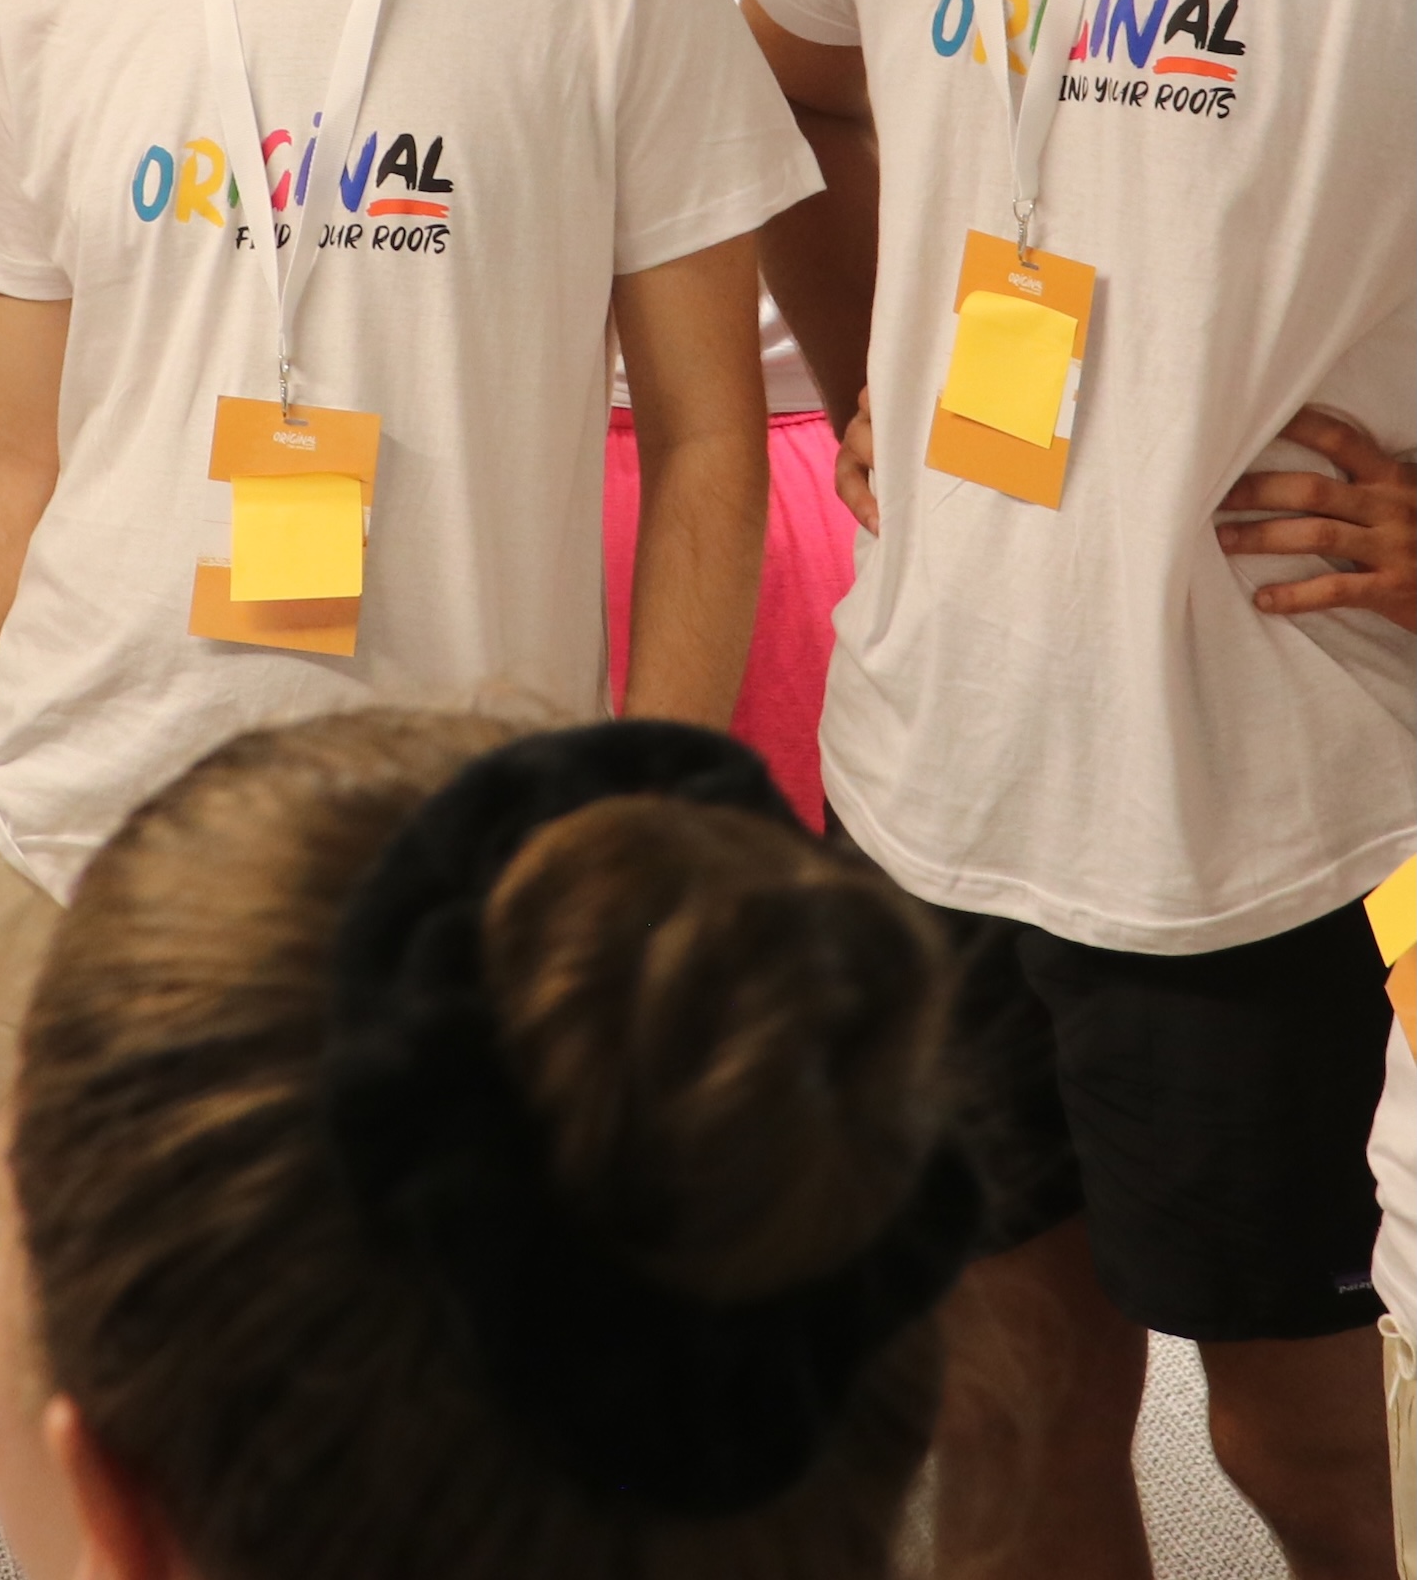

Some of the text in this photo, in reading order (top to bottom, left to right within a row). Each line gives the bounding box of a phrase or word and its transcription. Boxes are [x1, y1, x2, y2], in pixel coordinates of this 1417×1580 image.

[1058, 75, 1089, 102] IND
[1155, 84, 1237, 119] ROOTS
[372, 225, 450, 254] ROOTS
